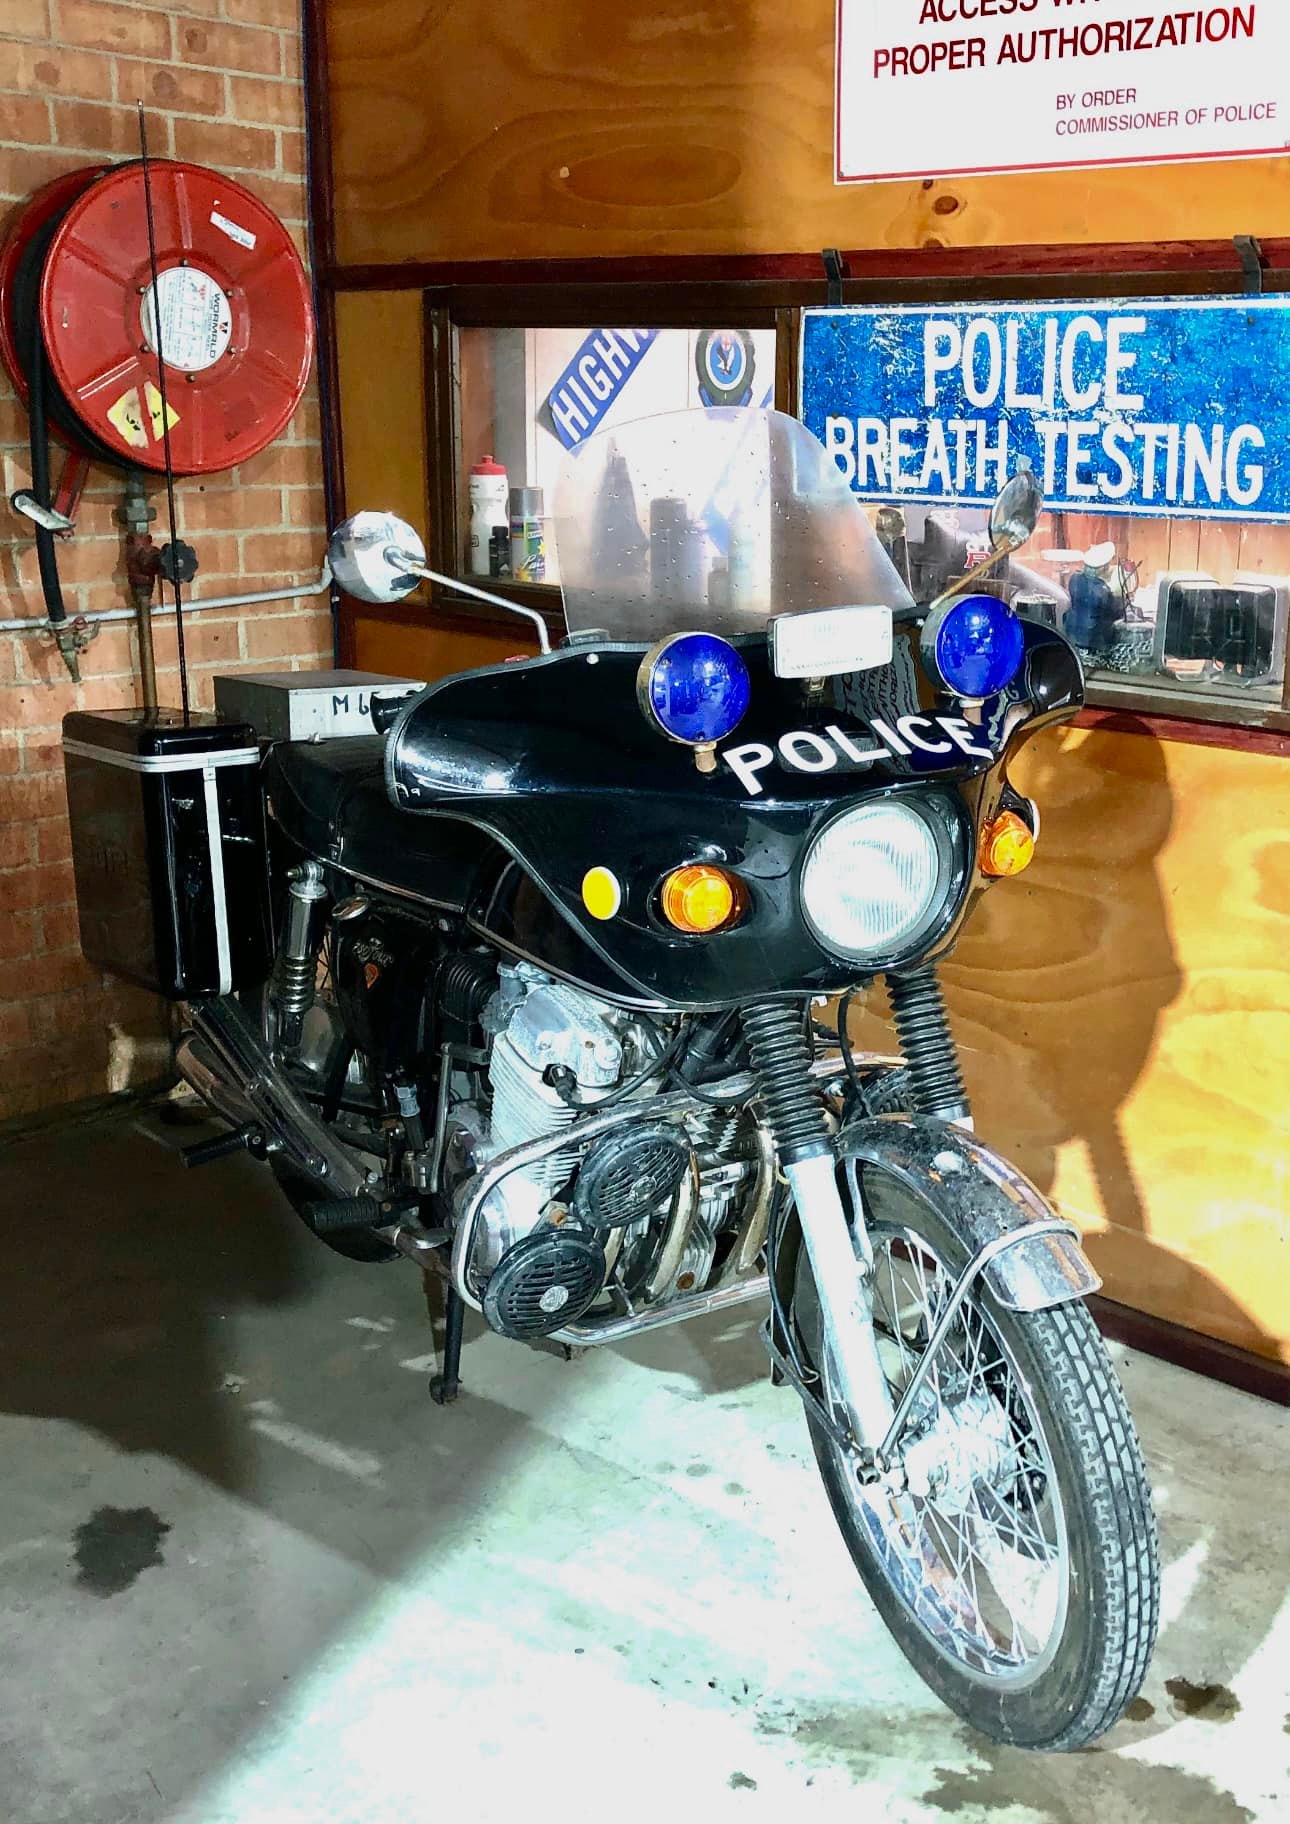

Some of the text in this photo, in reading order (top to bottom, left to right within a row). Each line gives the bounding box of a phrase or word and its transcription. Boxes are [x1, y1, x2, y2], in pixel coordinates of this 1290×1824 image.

[873, 4, 1256, 78] PROPER AUTHORIZATION
[1055, 102, 1277, 135] COMMISSIONER OF POLICE
[1056, 88, 1137, 110] BY ORDER
[210, 292, 221, 358] WORMALD
[923, 316, 1147, 411] POLICE
[825, 416, 1266, 506] BREATH TESTING
[722, 716, 995, 796] POLICE
